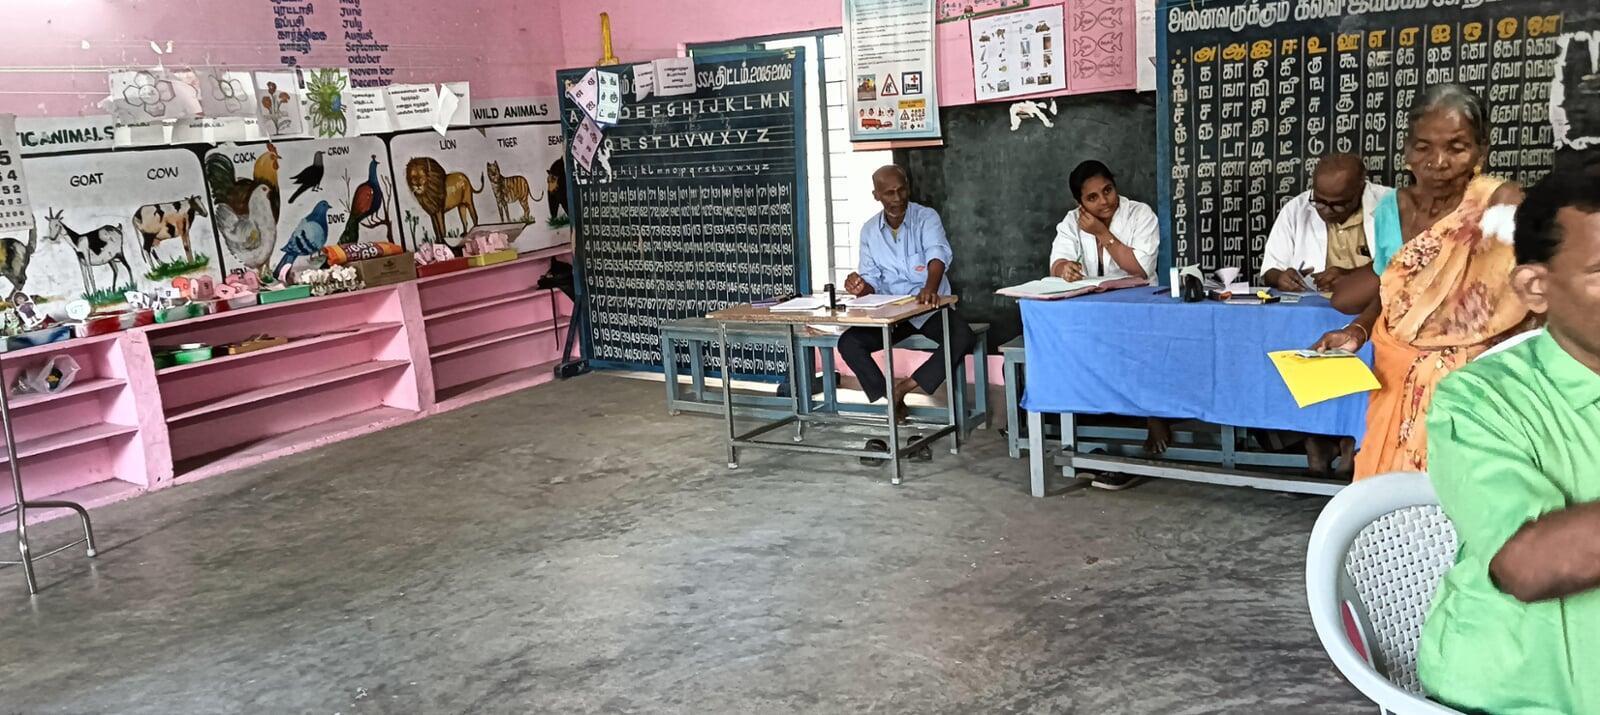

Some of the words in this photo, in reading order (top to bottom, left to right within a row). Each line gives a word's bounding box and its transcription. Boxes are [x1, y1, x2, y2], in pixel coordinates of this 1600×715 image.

[340, 7, 362, 17] June
[342, 17, 363, 32] July
[344, 29, 374, 42] August
[345, 41, 389, 54] September
[1194, 46, 1216, 62] அ
[1307, 36, 1327, 54] உ
[351, 77, 392, 89] December
[472, 107, 499, 120] WILD
[503, 104, 548, 119] ANIMALS
[570, 110, 578, 123] A
[636, 106, 645, 118] E
[652, 105, 660, 117] F
[667, 102, 675, 117] G
[683, 101, 691, 114] H
[699, 99, 704, 113] I
[709, 99, 718, 112] J
[726, 98, 735, 112] K
[744, 96, 752, 110] L
[761, 93, 772, 109] M
[779, 92, 790, 107] N
[439, 138, 457, 151] LION
[496, 136, 518, 148] TIGER
[639, 137, 647, 149] S
[652, 136, 662, 148] T
[685, 134, 695, 147] V
[699, 132, 714, 146] W
[720, 132, 730, 144] X
[757, 129, 770, 143] Z
[327, 146, 350, 156] CROW
[1200, 144, 1211, 160] ட
[1222, 142, 1245, 158] டா
[233, 152, 257, 164] COCK
[70, 173, 104, 187] GOAT
[147, 166, 179, 181] COW
[328, 213, 346, 225] DOVE
